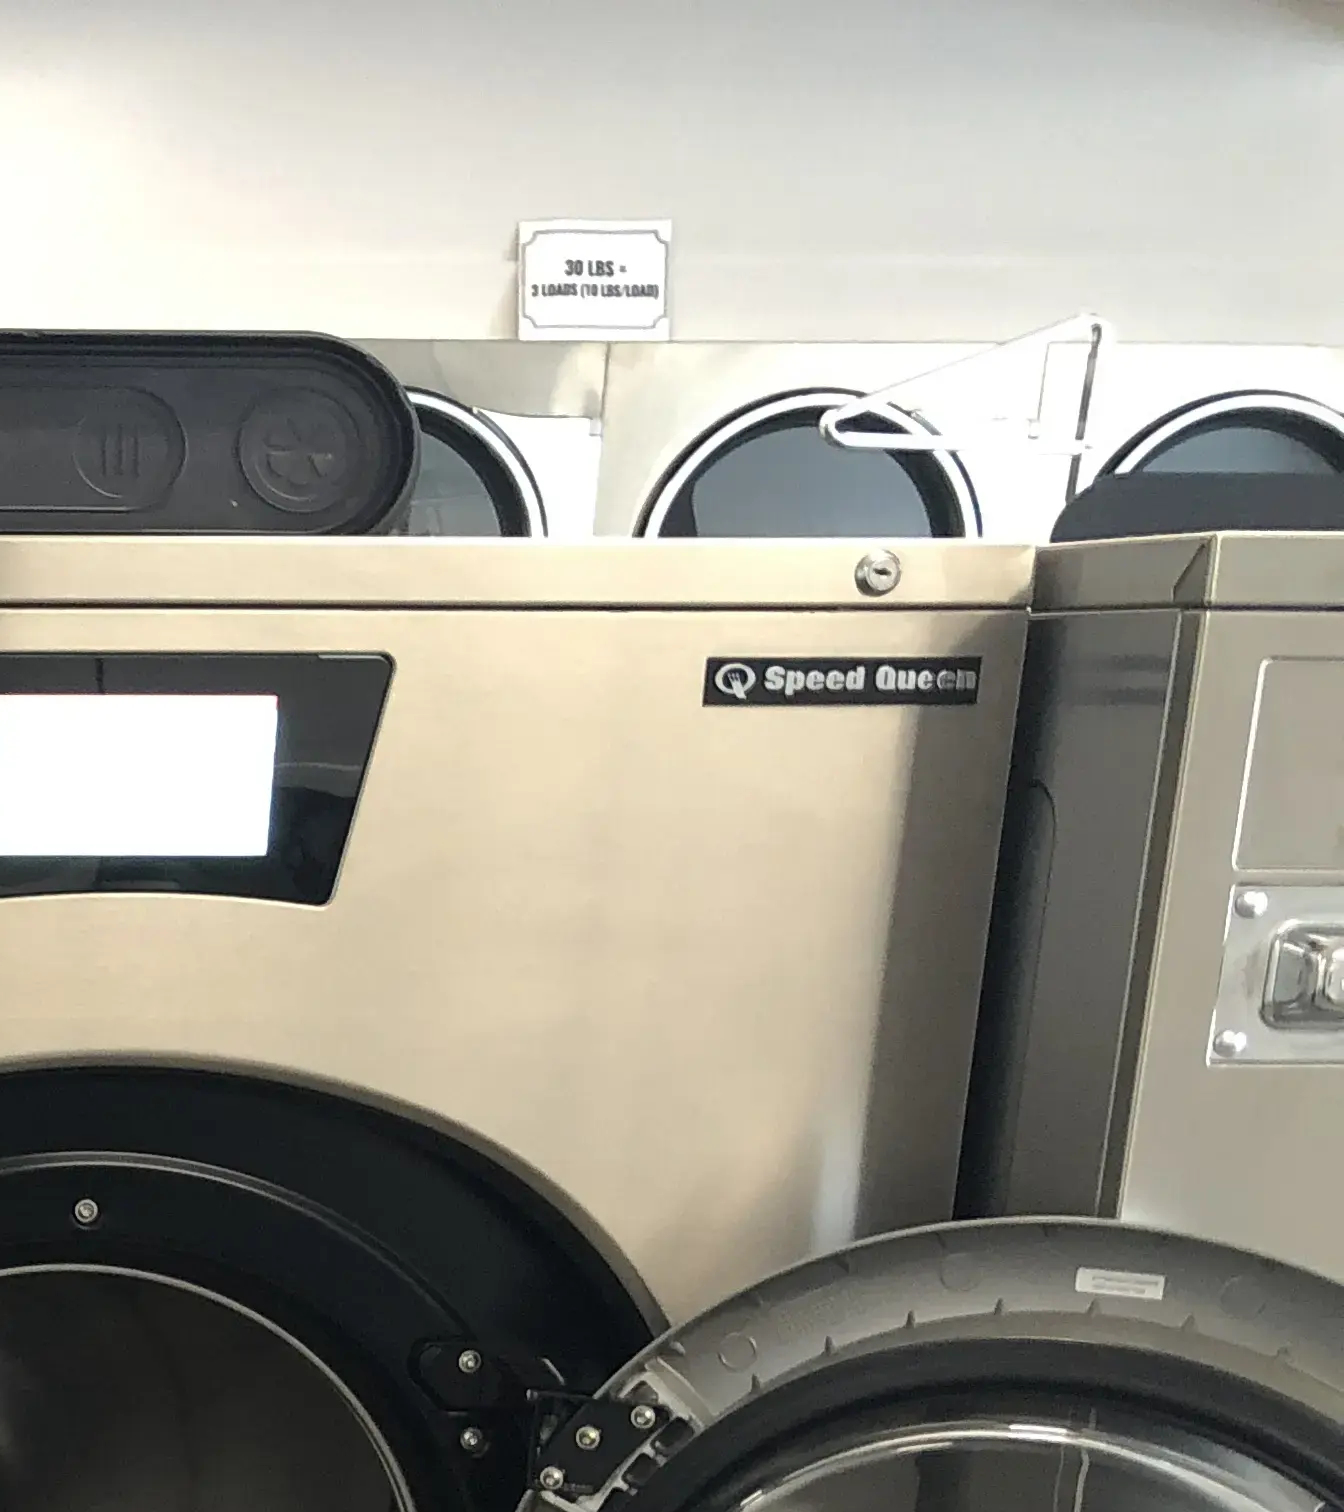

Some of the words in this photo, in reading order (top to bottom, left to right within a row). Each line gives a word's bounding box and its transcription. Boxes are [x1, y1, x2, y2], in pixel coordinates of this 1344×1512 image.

[564, 259, 583, 276] 30
[588, 260, 614, 277] LBS
[531, 283, 539, 297] 3
[541, 283, 578, 297] LOADS
[764, 664, 866, 696] Speed
[875, 664, 977, 692] Queen
